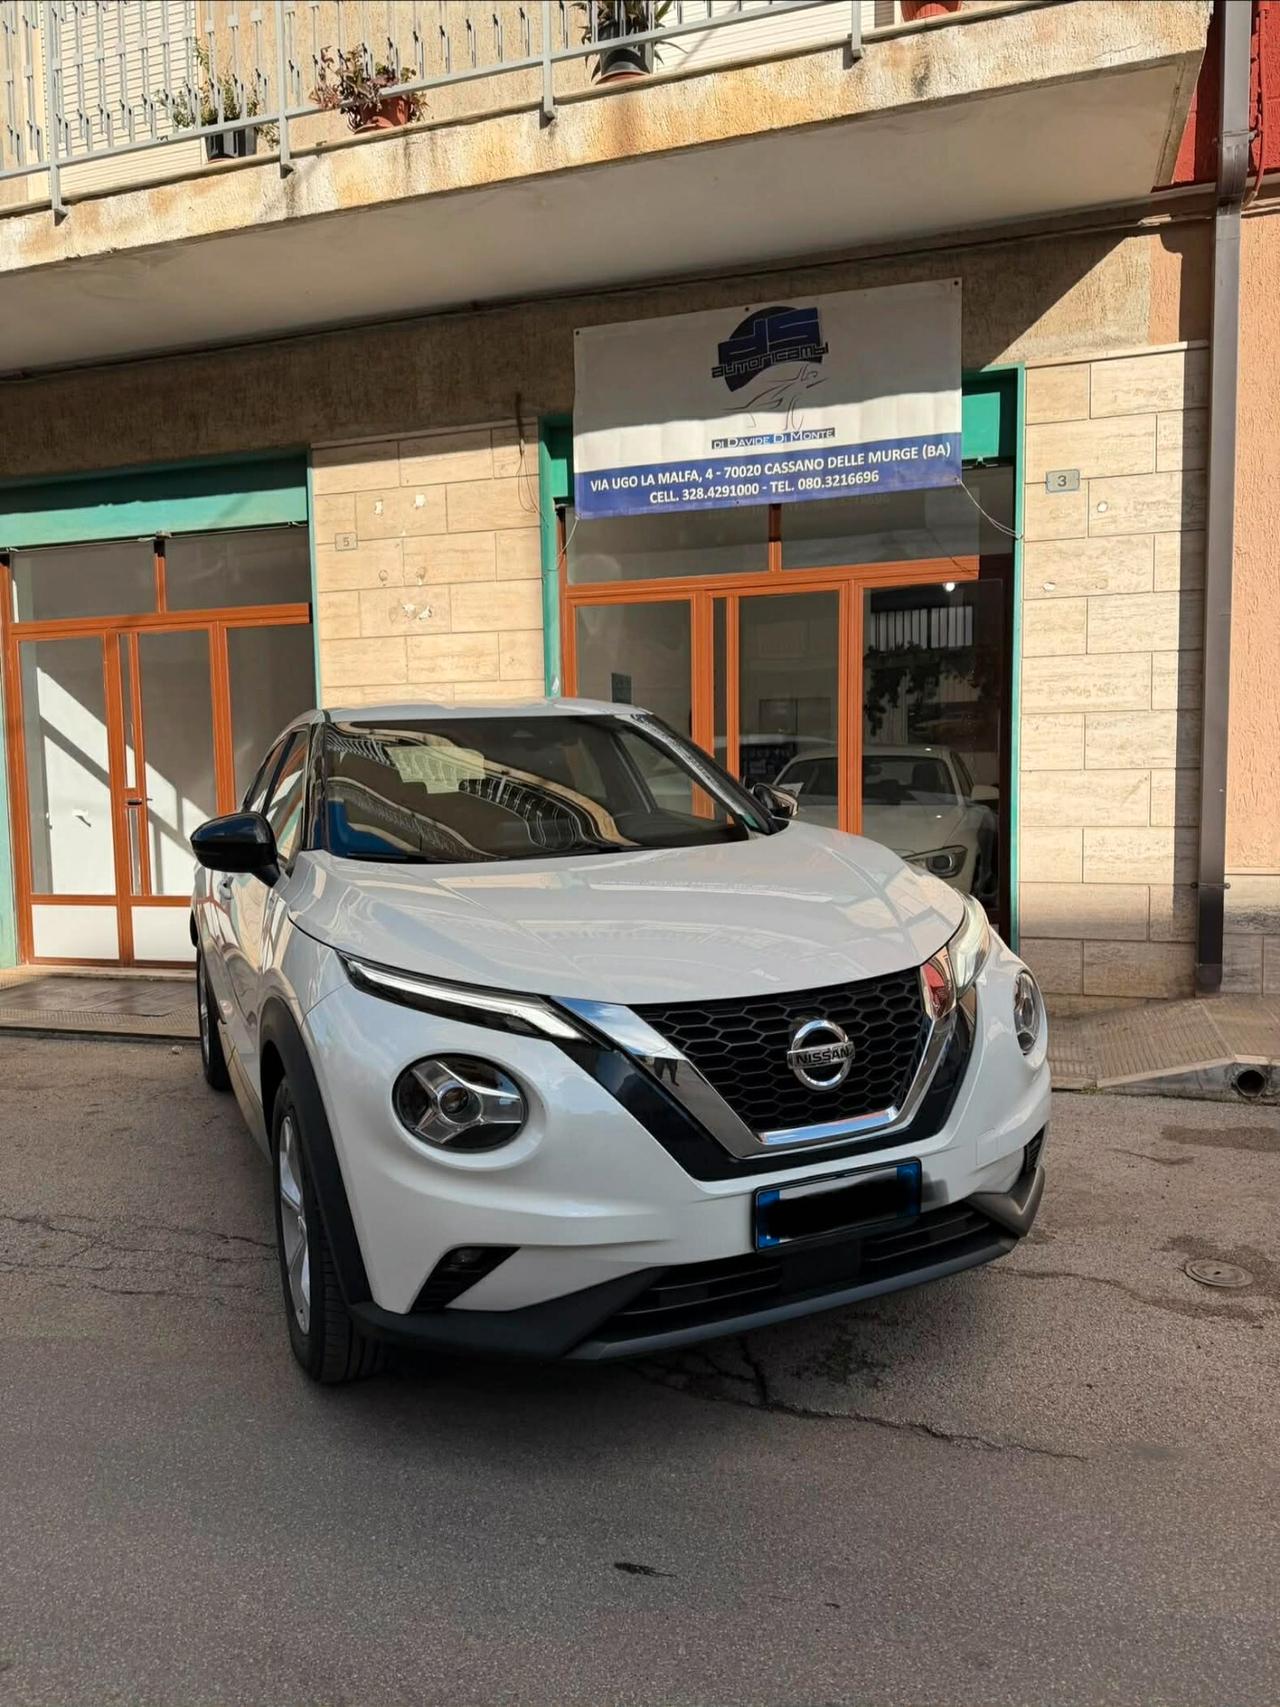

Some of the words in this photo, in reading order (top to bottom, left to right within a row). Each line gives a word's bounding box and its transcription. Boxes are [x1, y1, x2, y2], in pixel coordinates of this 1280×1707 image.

[590, 478, 609, 492] VIA
[612, 475, 637, 489] UGO
[641, 472, 655, 486] LA
[658, 469, 703, 485] MALFA,
[705, 468, 714, 480] 4
[724, 464, 762, 479] 70020
[764, 458, 825, 475] CASSANO
[828, 453, 865, 469] DELLE
[868, 447, 919, 463] MURGE
[922, 442, 951, 460] (BA)
[649, 491, 679, 504] CELL.
[682, 483, 760, 500] 328.4291000
[770, 480, 795, 493] TEL.
[797, 470, 880, 490] 080.3216696
[1057, 475, 1067, 487] 3
[343, 536, 350, 547] 5
[795, 1046, 850, 1064] NISSAN
